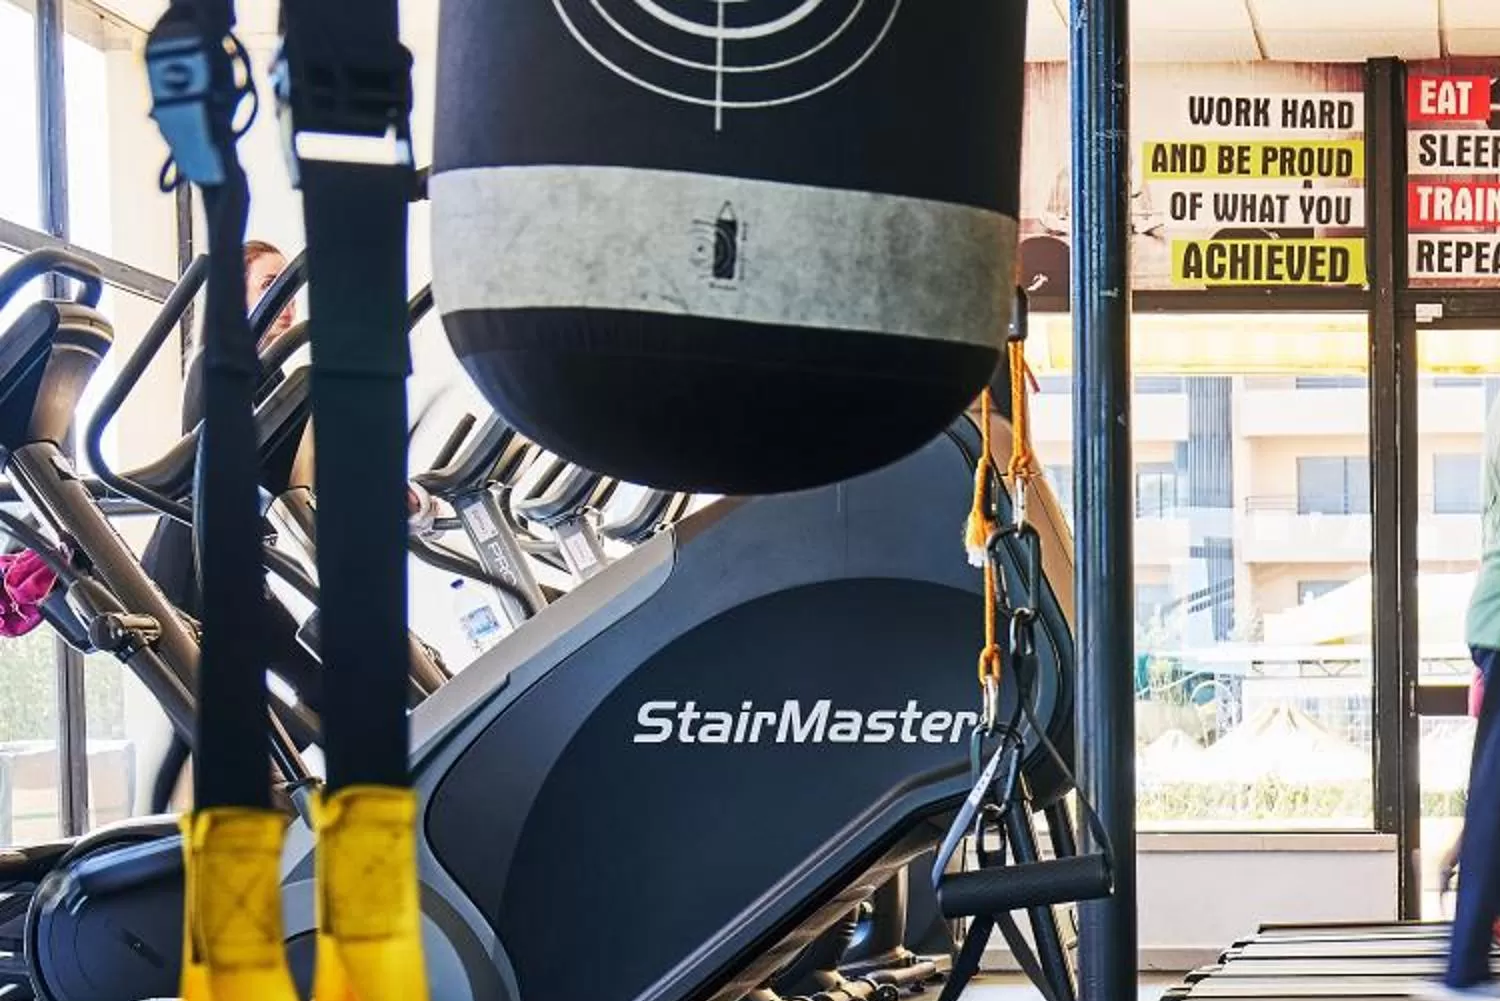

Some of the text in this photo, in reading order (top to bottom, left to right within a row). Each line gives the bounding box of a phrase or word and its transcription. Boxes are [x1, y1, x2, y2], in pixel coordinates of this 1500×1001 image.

[1189, 96, 1354, 129] WORK HARD
[1420, 79, 1472, 115] EAT
[1151, 143, 1353, 177] AND BE PROUD
[1170, 191, 1352, 225] OF WHAT YOU
[1182, 241, 1350, 283] ACHIEVED
[632, 699, 981, 744] StairMaster
